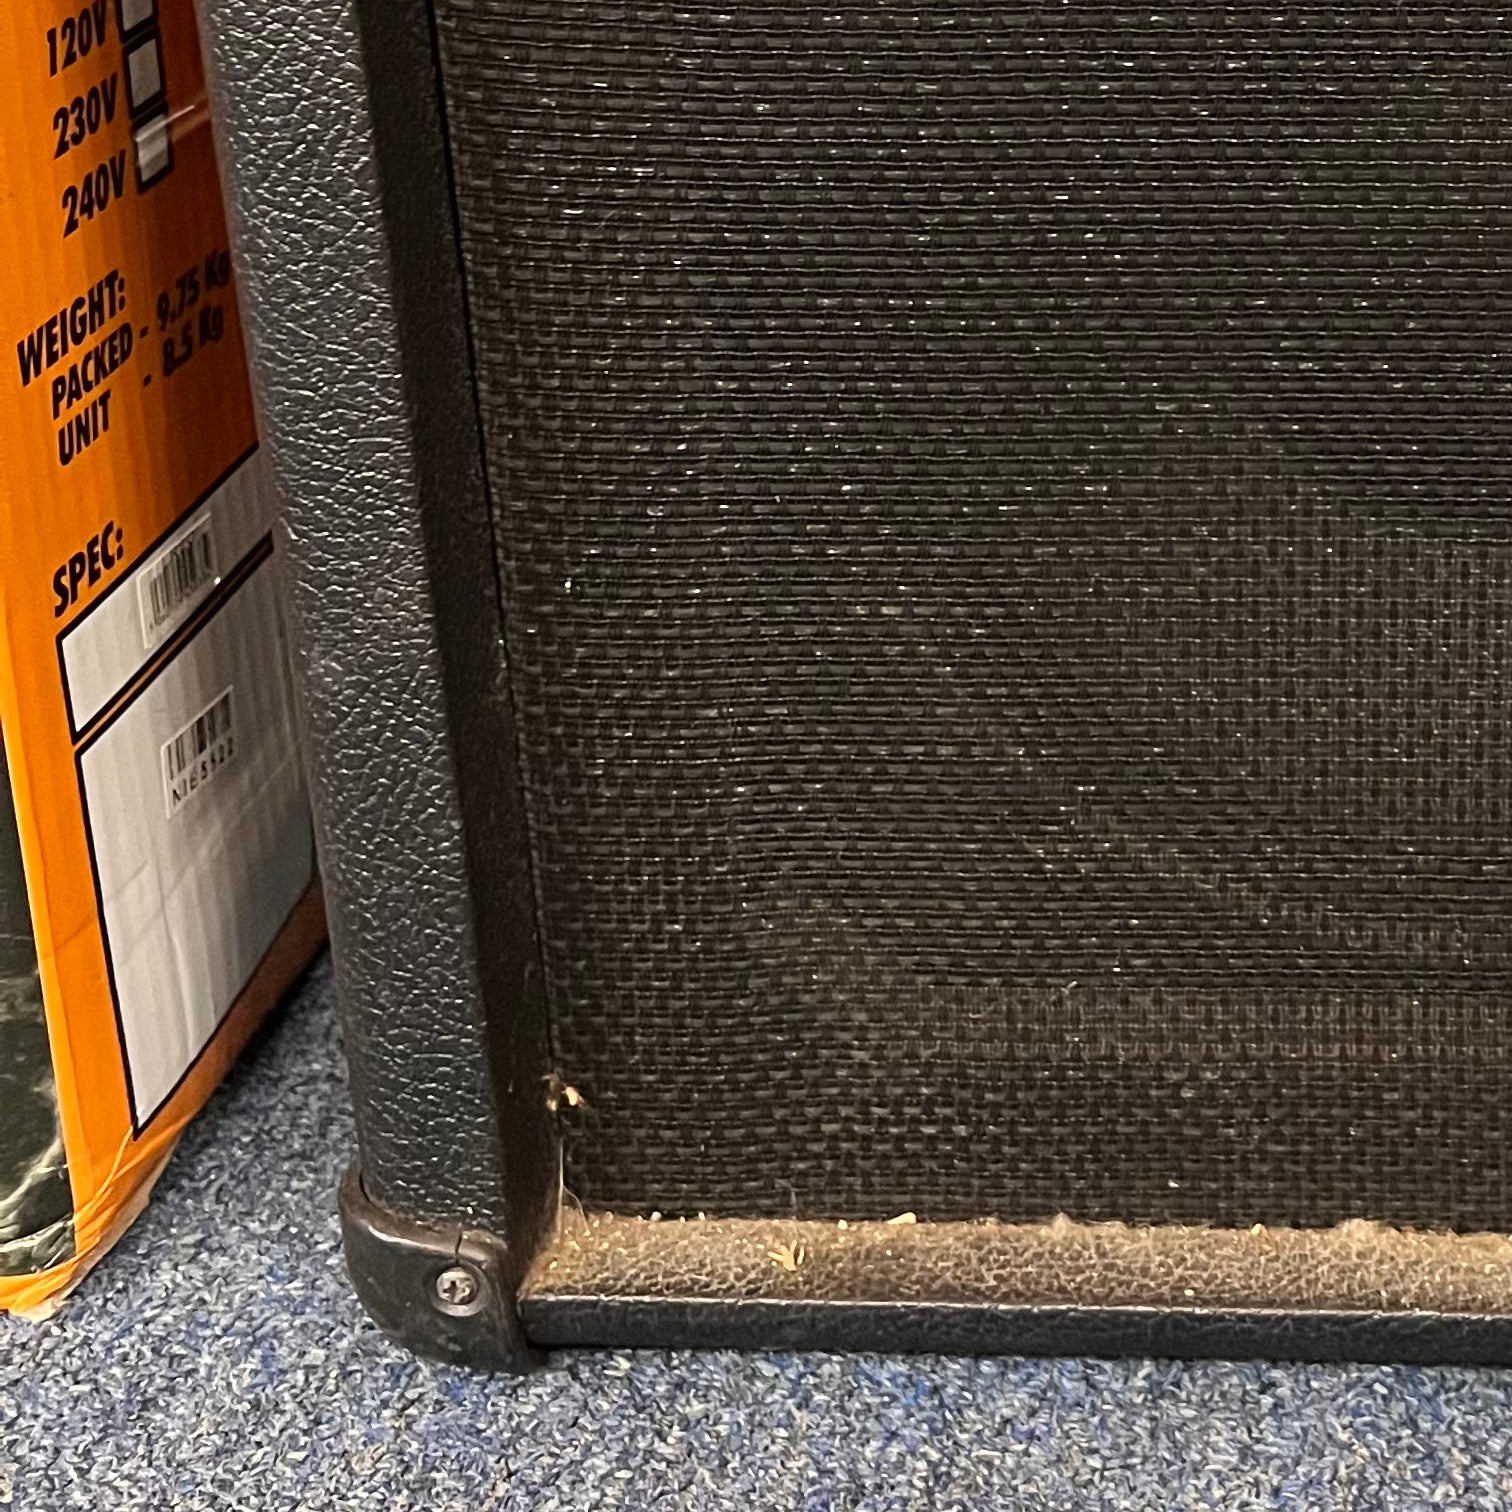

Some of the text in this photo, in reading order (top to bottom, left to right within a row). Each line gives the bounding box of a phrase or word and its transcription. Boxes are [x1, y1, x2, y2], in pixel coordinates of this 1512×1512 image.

[52, 72, 118, 160] 230V
[62, 148, 127, 239] 240V
[17, 269, 126, 387] WEIGHT:
[52, 322, 133, 420] PACKED
[58, 388, 111, 467] UNIT
[53, 520, 124, 619] SPEC:
